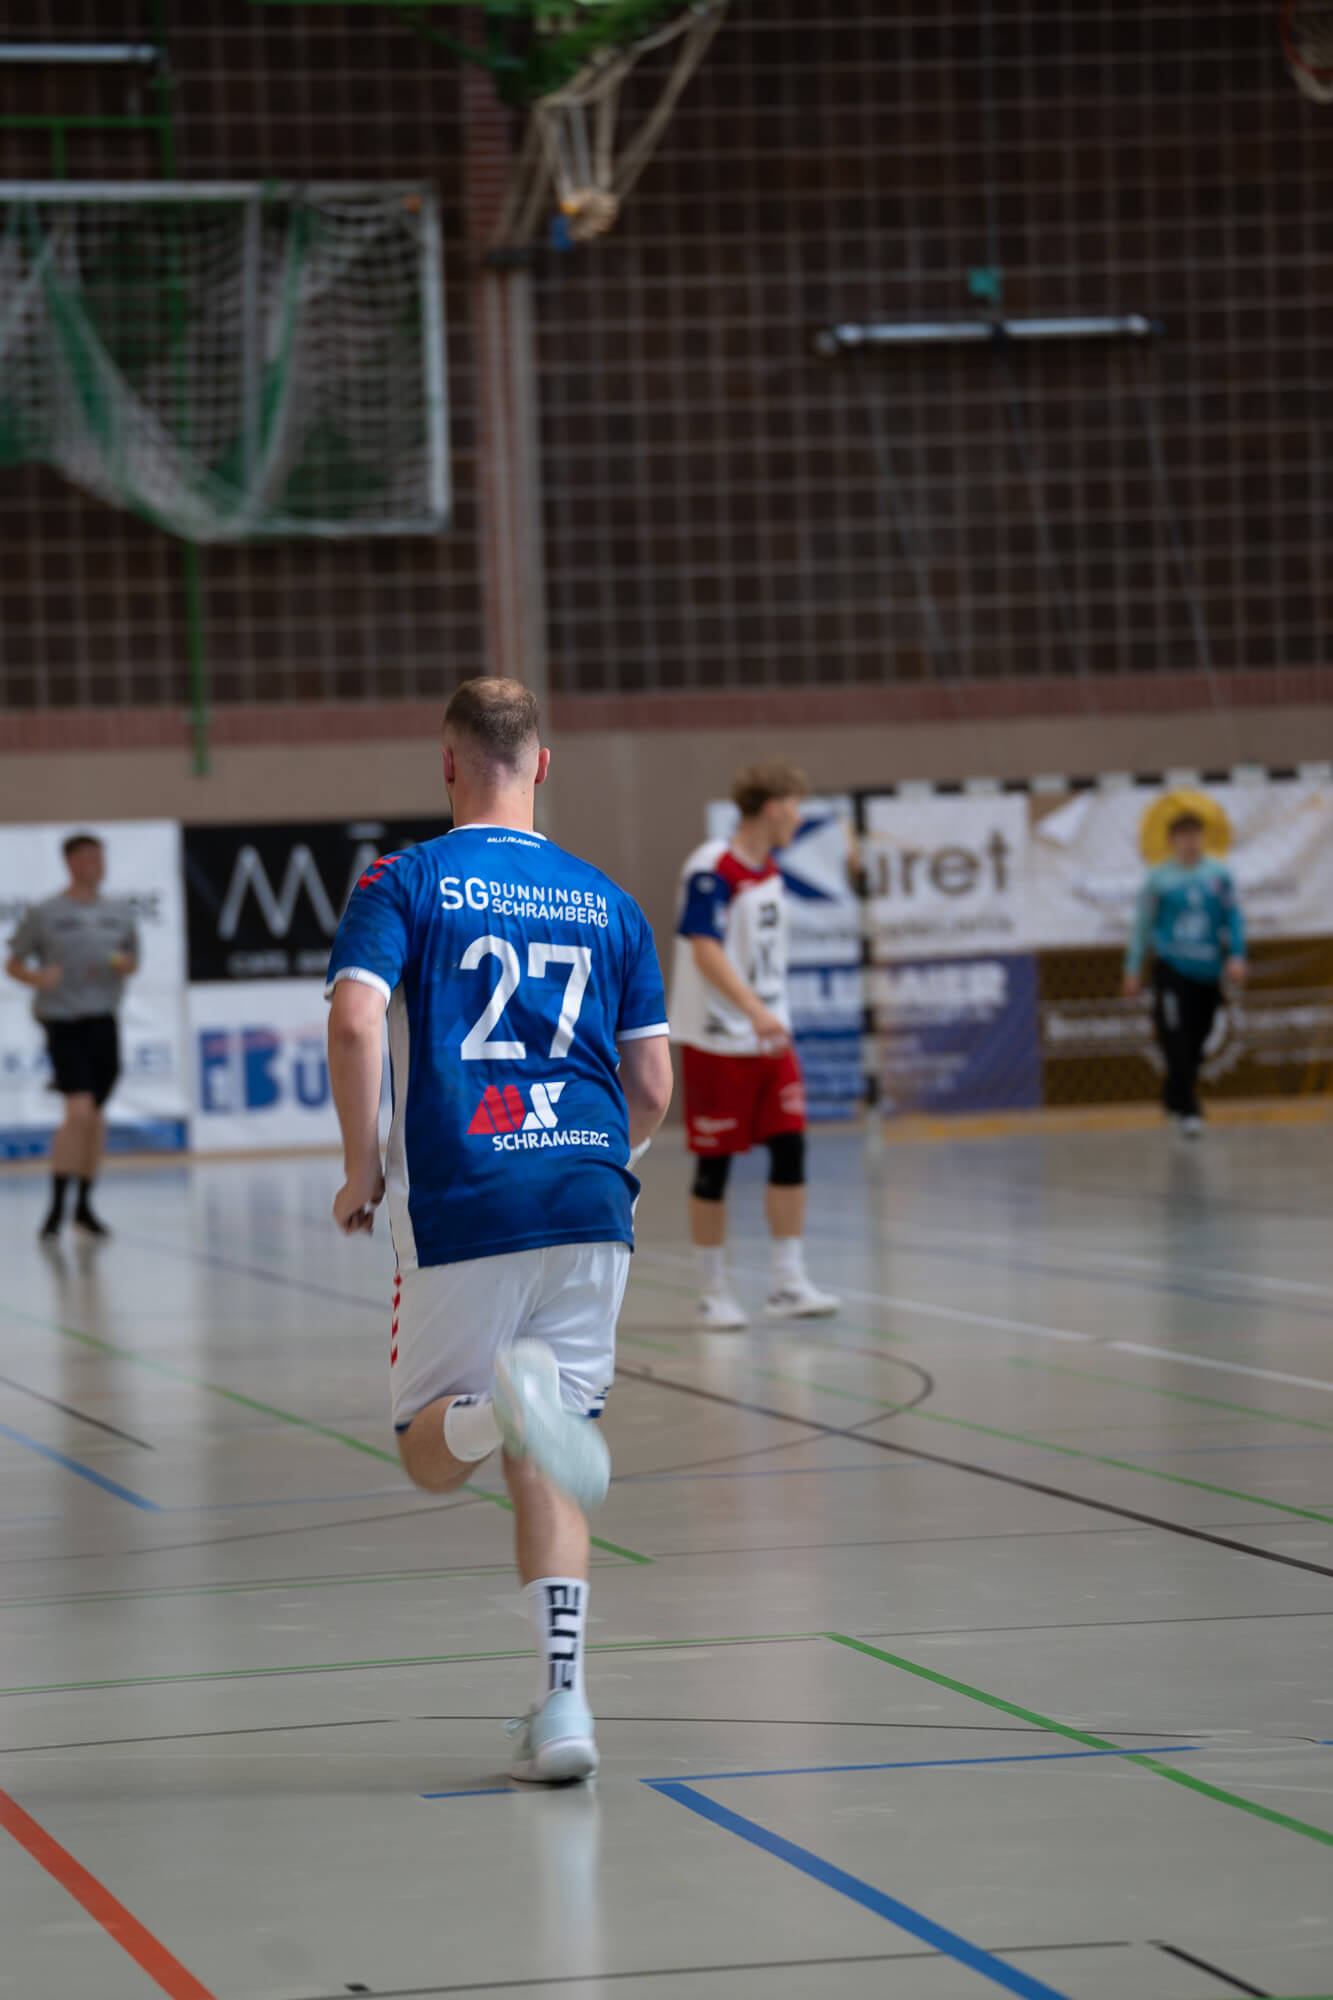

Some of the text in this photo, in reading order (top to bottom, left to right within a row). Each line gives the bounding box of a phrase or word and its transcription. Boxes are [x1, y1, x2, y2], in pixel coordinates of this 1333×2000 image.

[439, 876, 607, 911] SG DUNNINGEN
[492, 898, 609, 928] SCHRAMBERG
[459, 934, 592, 1061] 27
[492, 1129, 609, 1151] SCHRAMBERG
